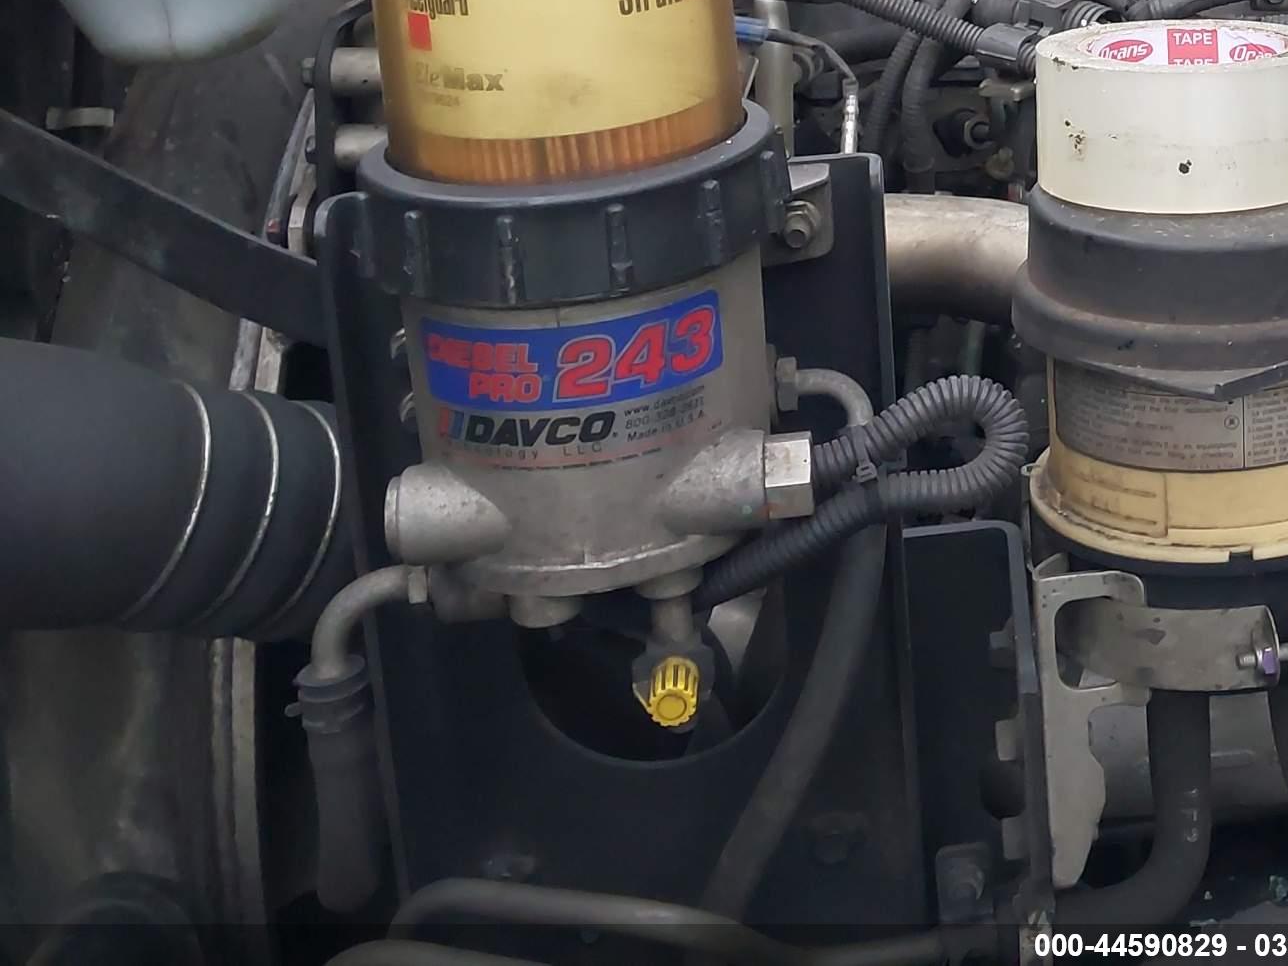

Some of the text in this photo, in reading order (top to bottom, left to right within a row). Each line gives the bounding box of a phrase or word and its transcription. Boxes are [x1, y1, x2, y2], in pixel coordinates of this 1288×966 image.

[1173, 32, 1213, 46] TAPE
[427, 333, 538, 373] DIESEL
[552, 305, 717, 403] 243
[469, 373, 542, 403] PRO
[464, 409, 616, 447] DAVCO
[562, 444, 602, 457] LLC
